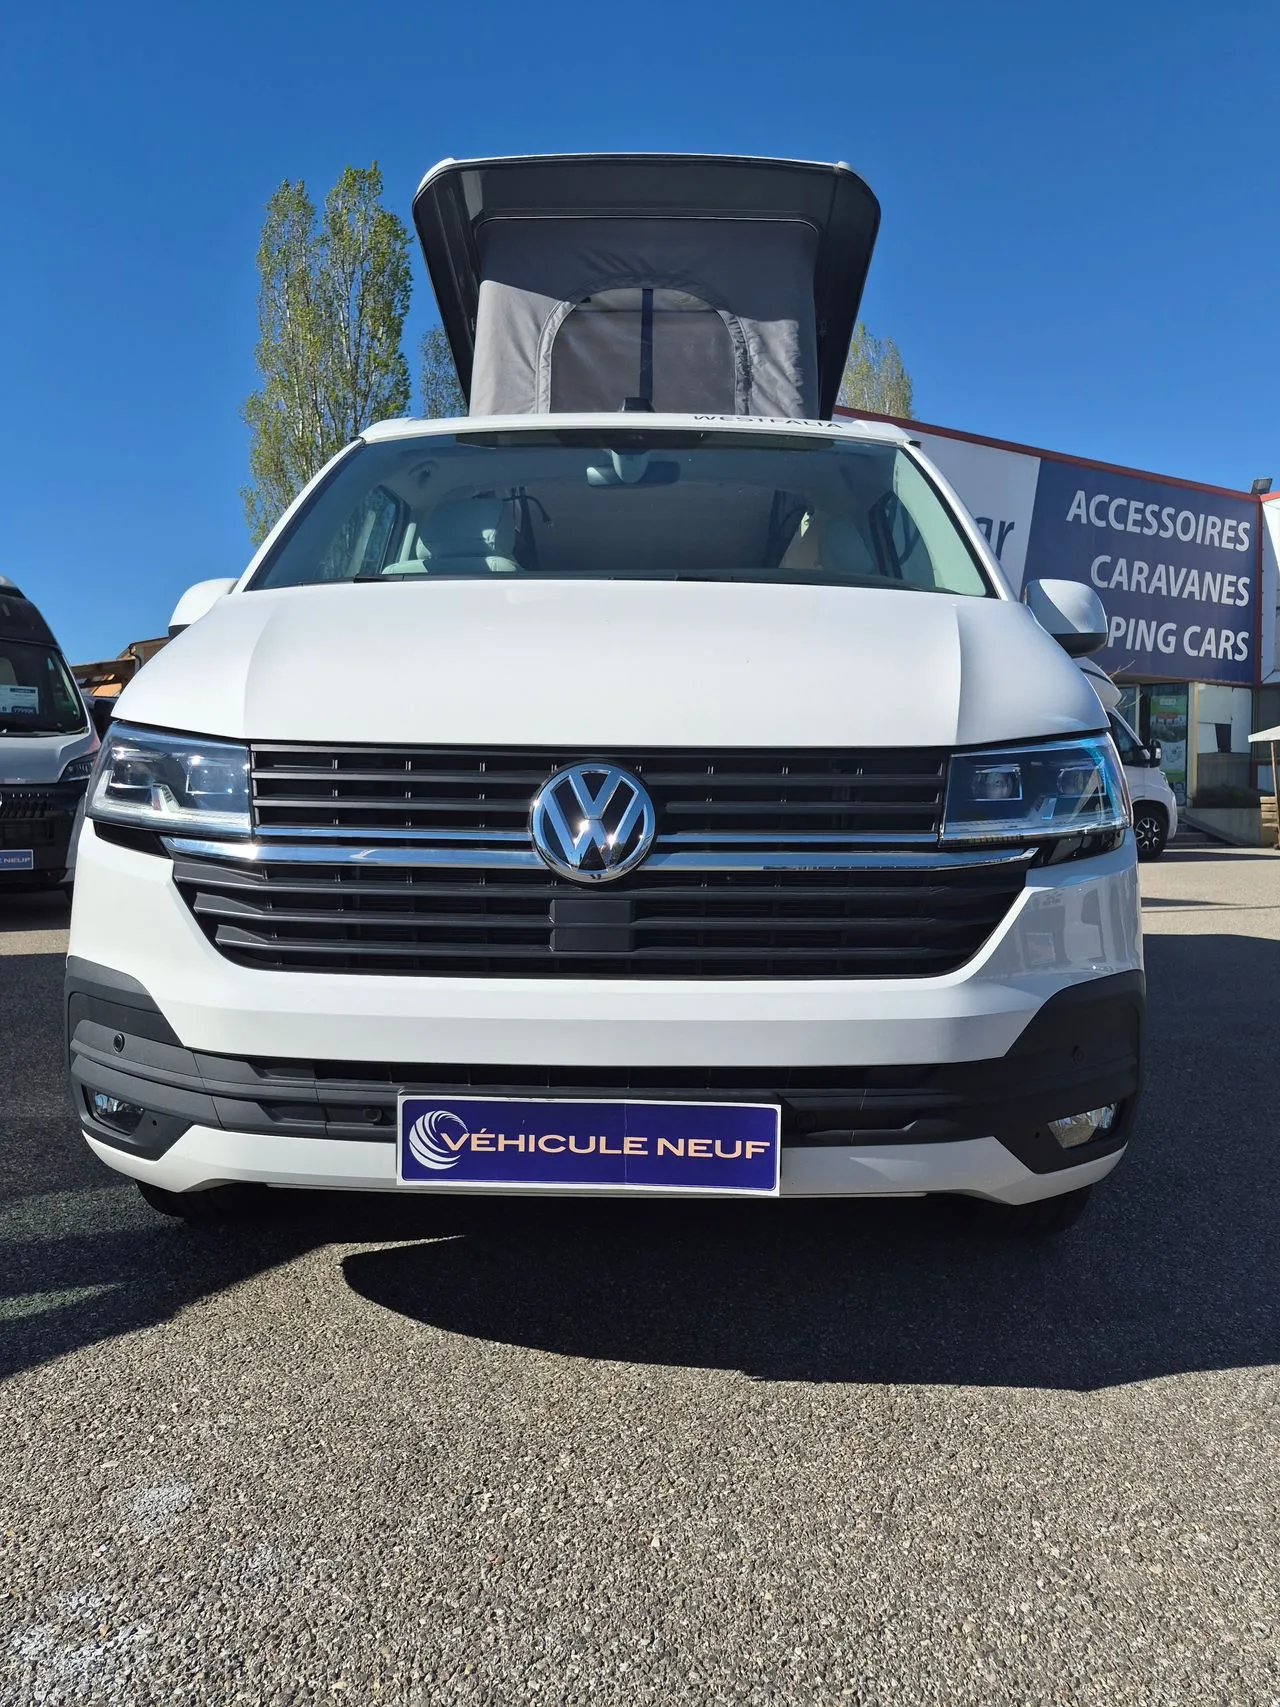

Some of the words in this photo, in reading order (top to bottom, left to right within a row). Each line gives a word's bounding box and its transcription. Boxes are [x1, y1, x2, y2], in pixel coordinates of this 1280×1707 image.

[694, 415, 843, 429] WESTFALIA
[1066, 490, 1251, 552] ACCESSOIRES
[1090, 555, 1251, 607] CARAVANES
[1183, 625, 1250, 662] CARS
[440, 1128, 649, 1156] VÉHICULE
[656, 1137, 771, 1160] NEUF
